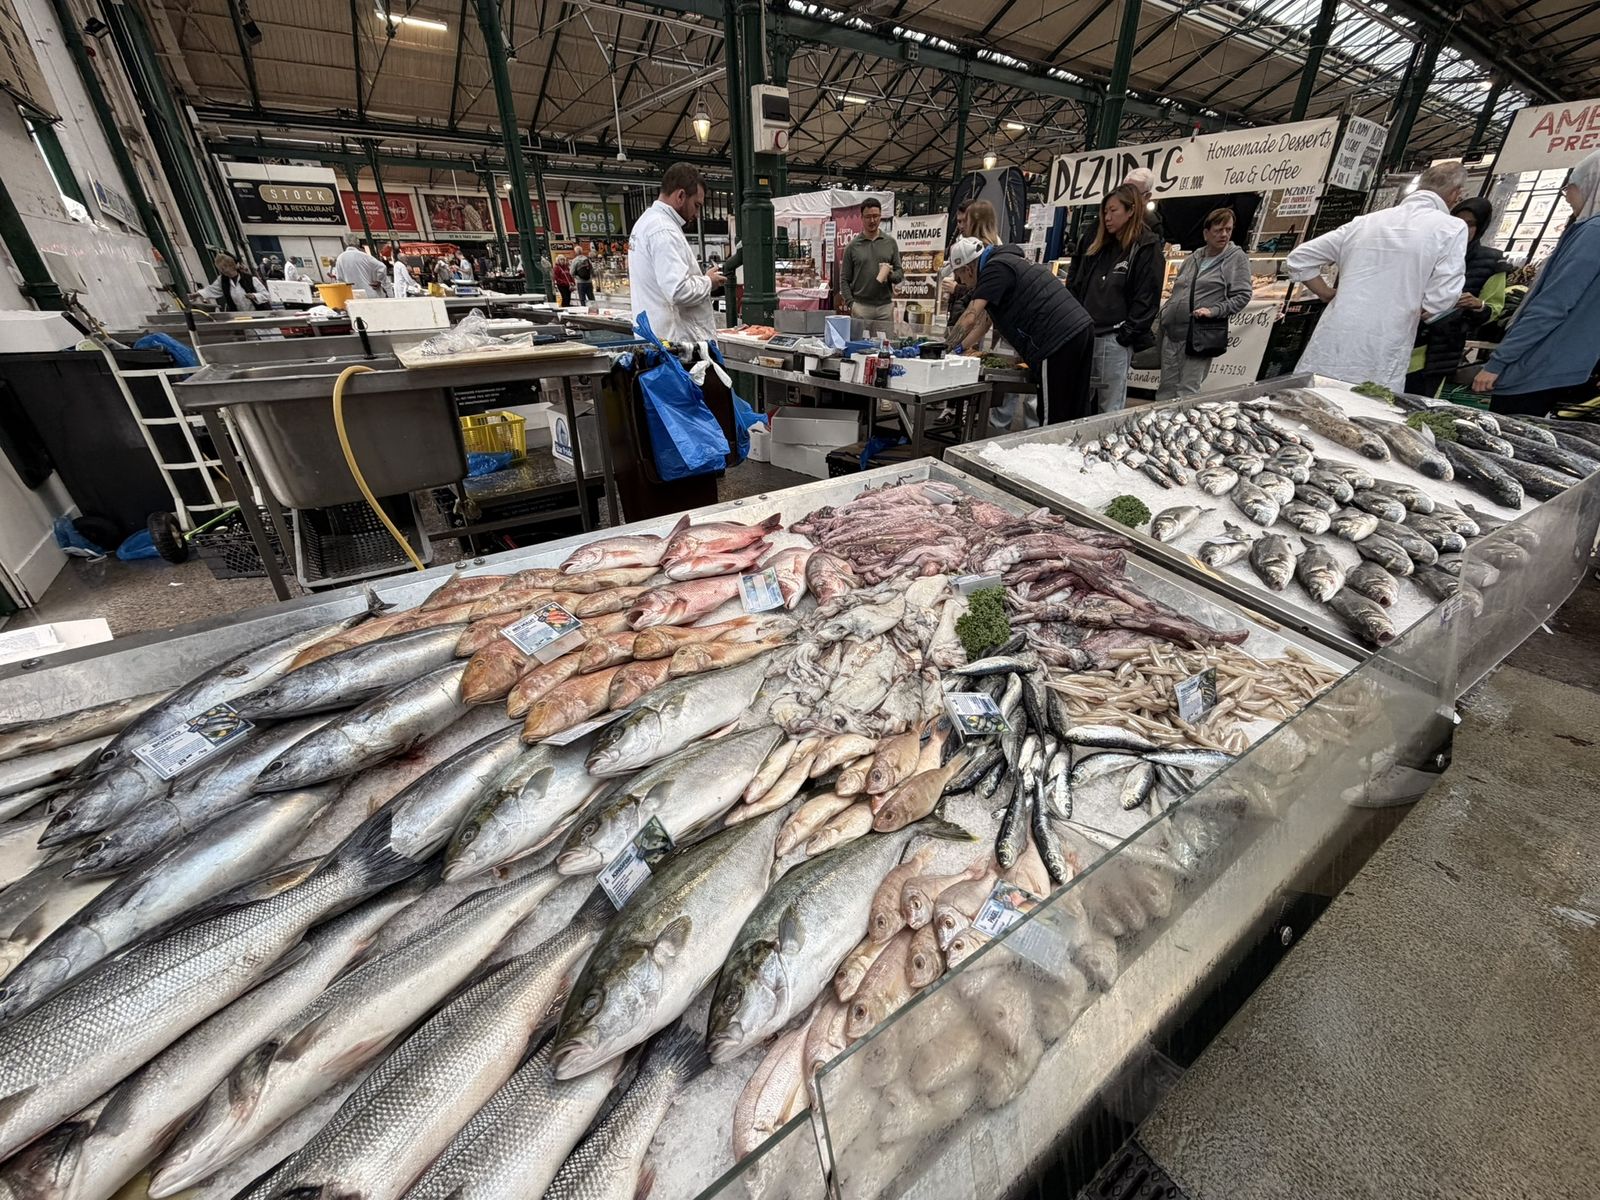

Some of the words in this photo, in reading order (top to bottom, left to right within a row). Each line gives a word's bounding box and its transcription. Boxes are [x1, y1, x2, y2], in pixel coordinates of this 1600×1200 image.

[1206, 133, 1277, 161] Homemade
[1224, 166, 1247, 185] Tea
[1247, 165, 1258, 184] &
[1260, 159, 1302, 184] Coffee
[270, 189, 325, 201] STOCK
[267, 204, 283, 212] BAR
[290, 205, 335, 213] RESTAURANT
[837, 229, 860, 246] fud
[896, 228, 942, 240] HOMEMADE
[902, 261, 933, 269] CRUMBLE
[901, 286, 928, 295] PUDDING
[1228, 309, 1270, 328] esserts,
[1220, 364, 1247, 376] 475150
[611, 852, 633, 879] KINGFISH
